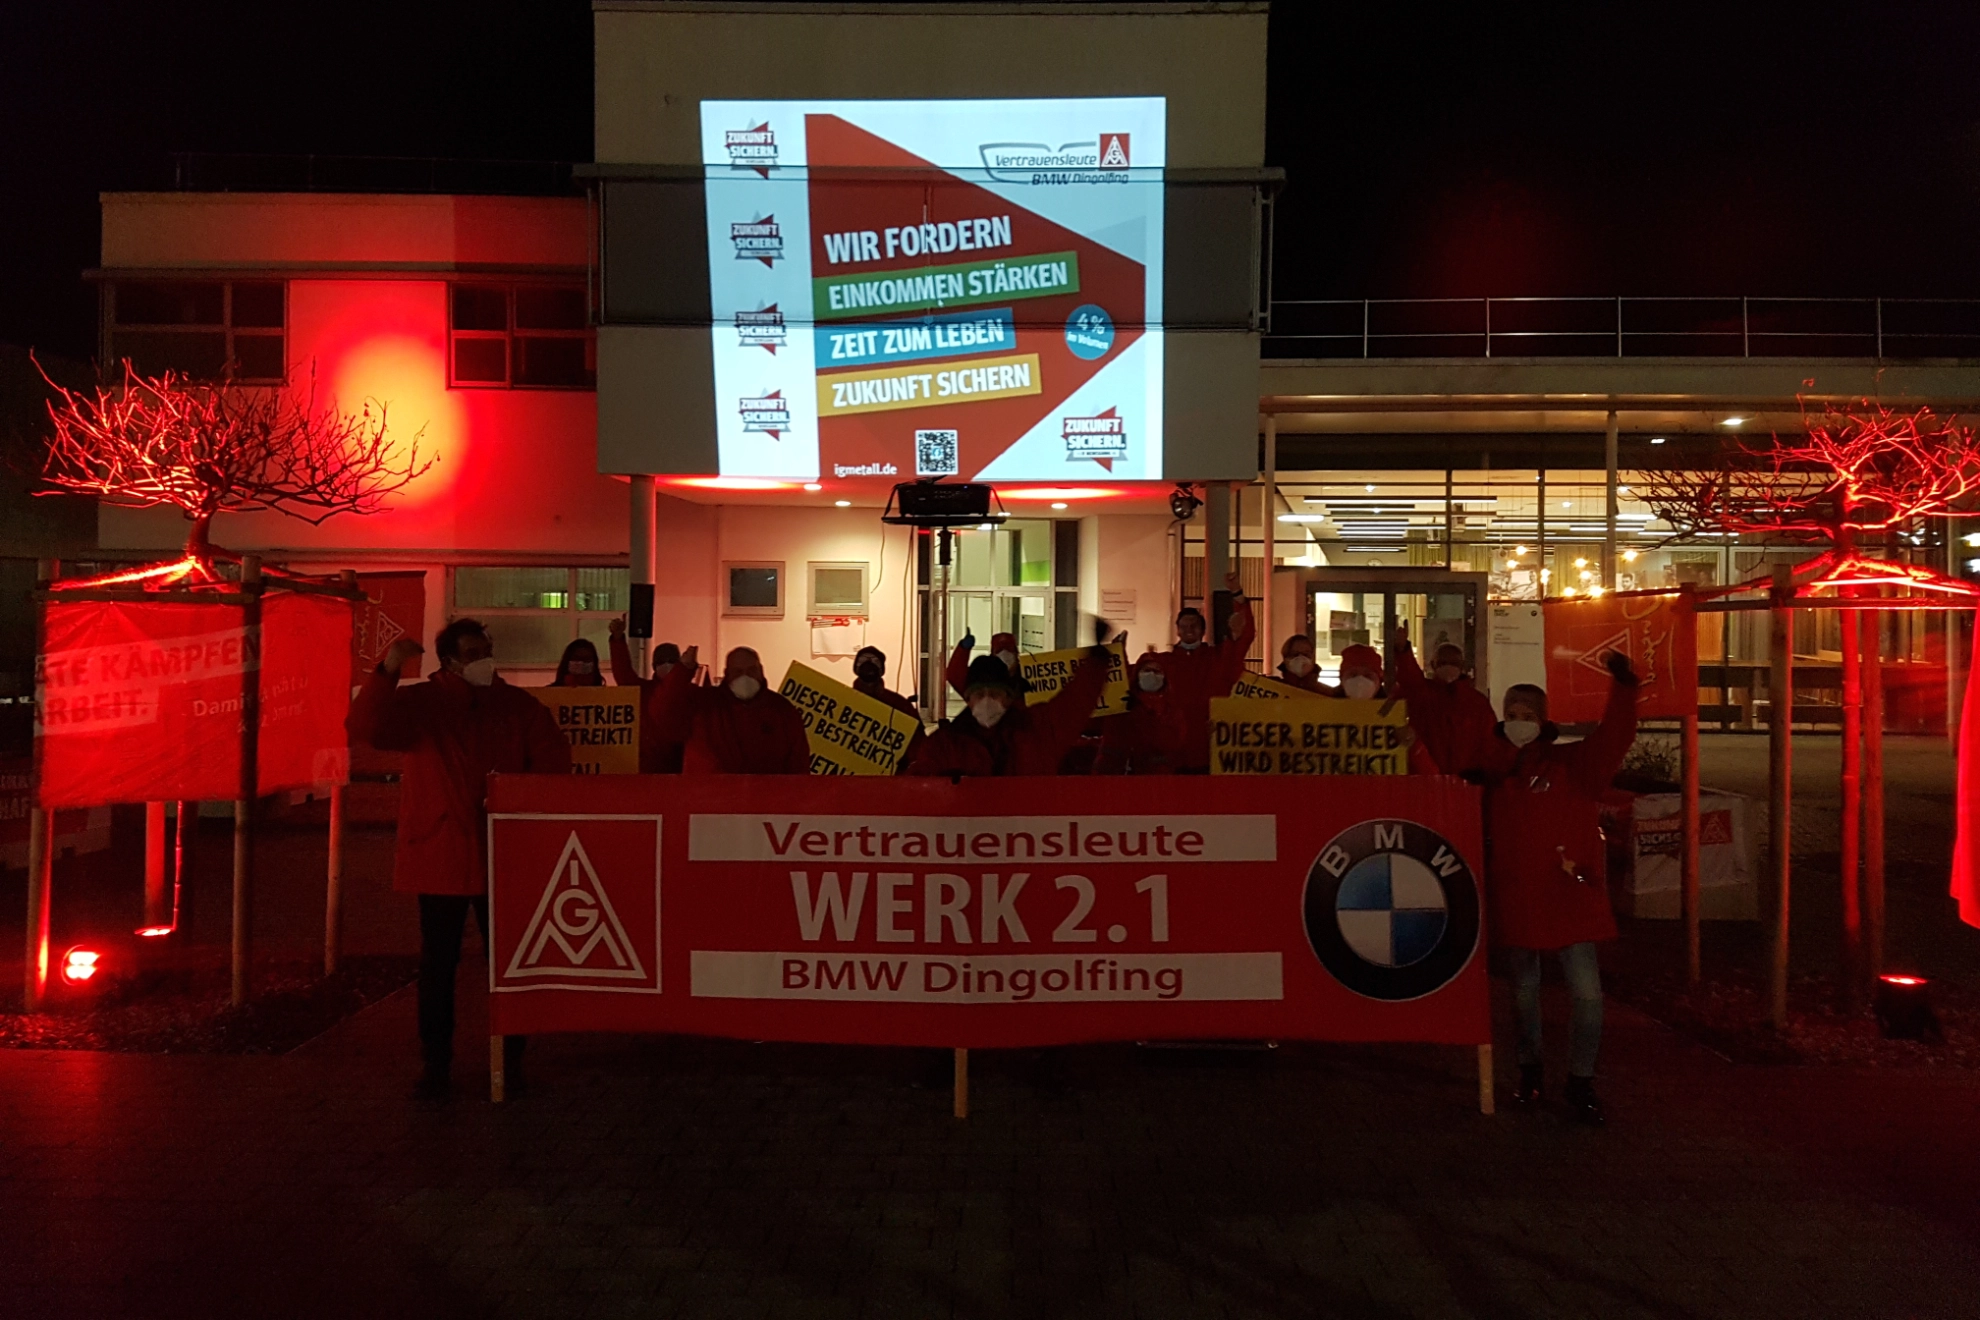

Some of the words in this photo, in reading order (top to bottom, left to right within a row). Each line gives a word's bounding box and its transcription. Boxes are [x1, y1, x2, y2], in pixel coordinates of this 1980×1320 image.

[995, 154, 1097, 166] Vertrauensleute
[1031, 174, 1070, 185] BMW
[1072, 173, 1129, 185] Dingolfing
[824, 230, 880, 264] WIR
[885, 215, 1012, 258] FORDERN
[828, 273, 964, 310] EINKOMMEN
[968, 261, 1068, 297] STÄRKEN
[830, 330, 878, 360] ZEIT
[883, 325, 931, 354] ZUM
[935, 319, 1005, 348] LEBEN
[832, 373, 932, 408] ZUKUNFT
[937, 363, 1031, 398] SICHERN
[1064, 418, 1121, 432] ZUKUNFT
[1067, 434, 1126, 449] SICHERN.
[834, 463, 897, 477] igmetall.de
[101, 632, 260, 681] KÄMPFEN
[1024, 661, 1068, 679] DIESER
[1029, 678, 1058, 693] WIRD
[558, 704, 635, 725] BETRIEB
[781, 678, 838, 719] DIESER
[838, 706, 906, 750] BETRIEB
[814, 718, 896, 769] BESTREIKT!
[1216, 721, 1294, 747] DIESER
[1302, 723, 1401, 749] BETRIEB
[1218, 751, 1272, 773] WIRD
[763, 820, 1205, 858] Vertrauensleute
[1319, 823, 1463, 879] BMW
[789, 870, 1032, 944] WERK
[1052, 873, 1170, 943] 2.1
[782, 958, 908, 992] BMW
[924, 958, 1184, 1000] Dingolfing
